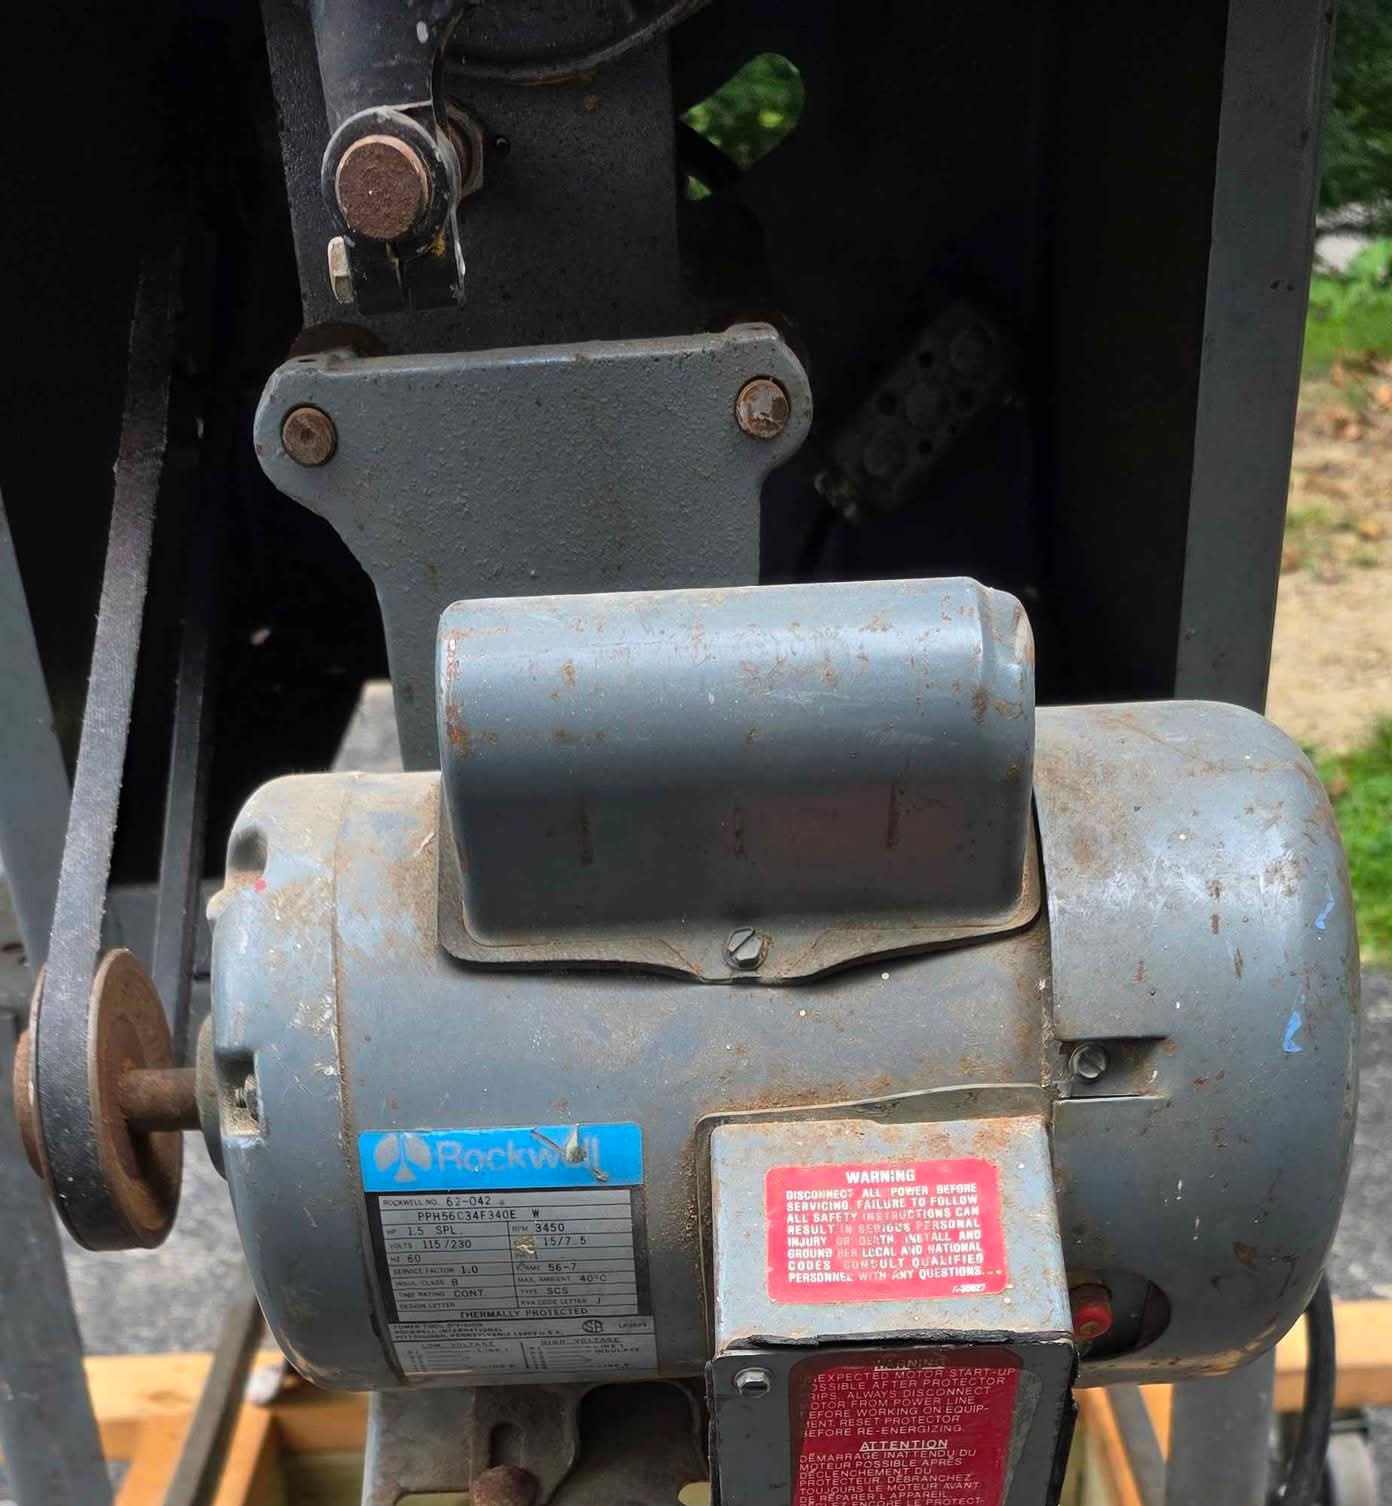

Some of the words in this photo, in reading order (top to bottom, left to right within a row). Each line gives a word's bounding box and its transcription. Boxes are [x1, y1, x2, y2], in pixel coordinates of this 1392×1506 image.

[437, 1136, 599, 1170] Rockwll
[846, 1169, 916, 1184] WARNING
[785, 1188, 854, 1200] DISCONNECT
[862, 1188, 881, 1198] ALL
[890, 1185, 928, 1197] POWER
[936, 1183, 977, 1195] BEFORE
[383, 1199, 422, 1207] ROCKWELL
[446, 1196, 492, 1207] 62-042
[856, 1198, 905, 1210] FAILURE
[911, 1197, 926, 1207] TO
[930, 1194, 978, 1207] FOLLOW
[417, 1209, 518, 1222] PPH56C34F340E
[532, 1208, 540, 1219] W
[787, 1213, 808, 1224] ALL
[813, 1211, 857, 1223] SAFETY
[863, 1207, 951, 1221] INSTRUCTIONS
[955, 1206, 979, 1217] CAN
[407, 1226, 425, 1236] 1.5
[512, 1225, 528, 1233] RPM
[535, 1223, 565, 1233] 3450
[787, 1224, 835, 1235] RESULT
[841, 1224, 853, 1234] IN
[858, 1222, 911, 1234] SERIOUS
[916, 1219, 980, 1231] PERSONAL
[787, 1236, 827, 1248] INJURY
[836, 1236, 850, 1246] OR
[905, 1231, 951, 1244] INSTALL
[959, 1230, 982, 1241] AND
[787, 1247, 832, 1259] GROUND
[837, 1248, 857, 1258] PER
[862, 1245, 896, 1257] LOCAL
[901, 1245, 922, 1256] AND
[928, 1241, 982, 1254] NATIONAL
[407, 1254, 422, 1263] 60
[788, 1259, 831, 1272] CODES
[843, 1257, 905, 1270] CONSULT
[912, 1253, 984, 1268] QUALIFIED
[461, 1265, 479, 1275] 1.0
[548, 1262, 577, 1272] 56-7
[788, 1271, 853, 1283] PERSONNEL
[859, 1271, 886, 1281] WITH
[892, 1269, 914, 1280] ANY
[546, 1286, 569, 1295] SCS
[460, 1310, 521, 1319] THERMALLY
[525, 1307, 588, 1317] PROTECTED
[895, 1369, 943, 1380] MOTOR
[949, 1367, 1017, 1378] START-UP
[806, 1382, 865, 1393] OSSIBLE
[872, 1380, 919, 1390] AFTER
[923, 1376, 1006, 1387] PROTECTOR
[807, 1391, 842, 1402] RIPS.
[849, 1389, 898, 1401] ALWAYS
[902, 1386, 992, 1398] DISCONNECT
[808, 1402, 846, 1412] OTOR
[850, 1399, 889, 1410] FROM
[893, 1397, 942, 1408] POWER
[947, 1395, 976, 1405] LINE
[806, 1409, 850, 1420] EFORE
[856, 1407, 918, 1418] WORKING
[923, 1405, 943, 1415] ON
[945, 1403, 990, 1415] EQUIP-
[839, 1417, 880, 1427] RESET
[884, 1414, 961, 1425] PROTECTOR
[857, 1422, 965, 1436] RE-ENERGIZING.
[860, 1439, 949, 1451] ATTENTION
[800, 1451, 879, 1463] DÉMARRAGE
[884, 1449, 955, 1460] INATTENDU
[959, 1449, 977, 1457] DU
[800, 1461, 851, 1472] MOTEUR
[856, 1459, 917, 1469] POSSIBLE
[800, 1467, 911, 1480] DÉCLENCHEMENT
[915, 1466, 932, 1475] DU
[800, 1485, 864, 1497] TOUJOURS
[868, 1484, 884, 1493] LE
[887, 1482, 938, 1492] MOTEUR
[943, 1481, 981, 1490] AVANT
[800, 1495, 816, 1504] DE
[820, 1493, 876, 1503] RÉPARER
[906, 1498, 921, 1506] LE
[925, 1497, 985, 1506] PROTECT-
